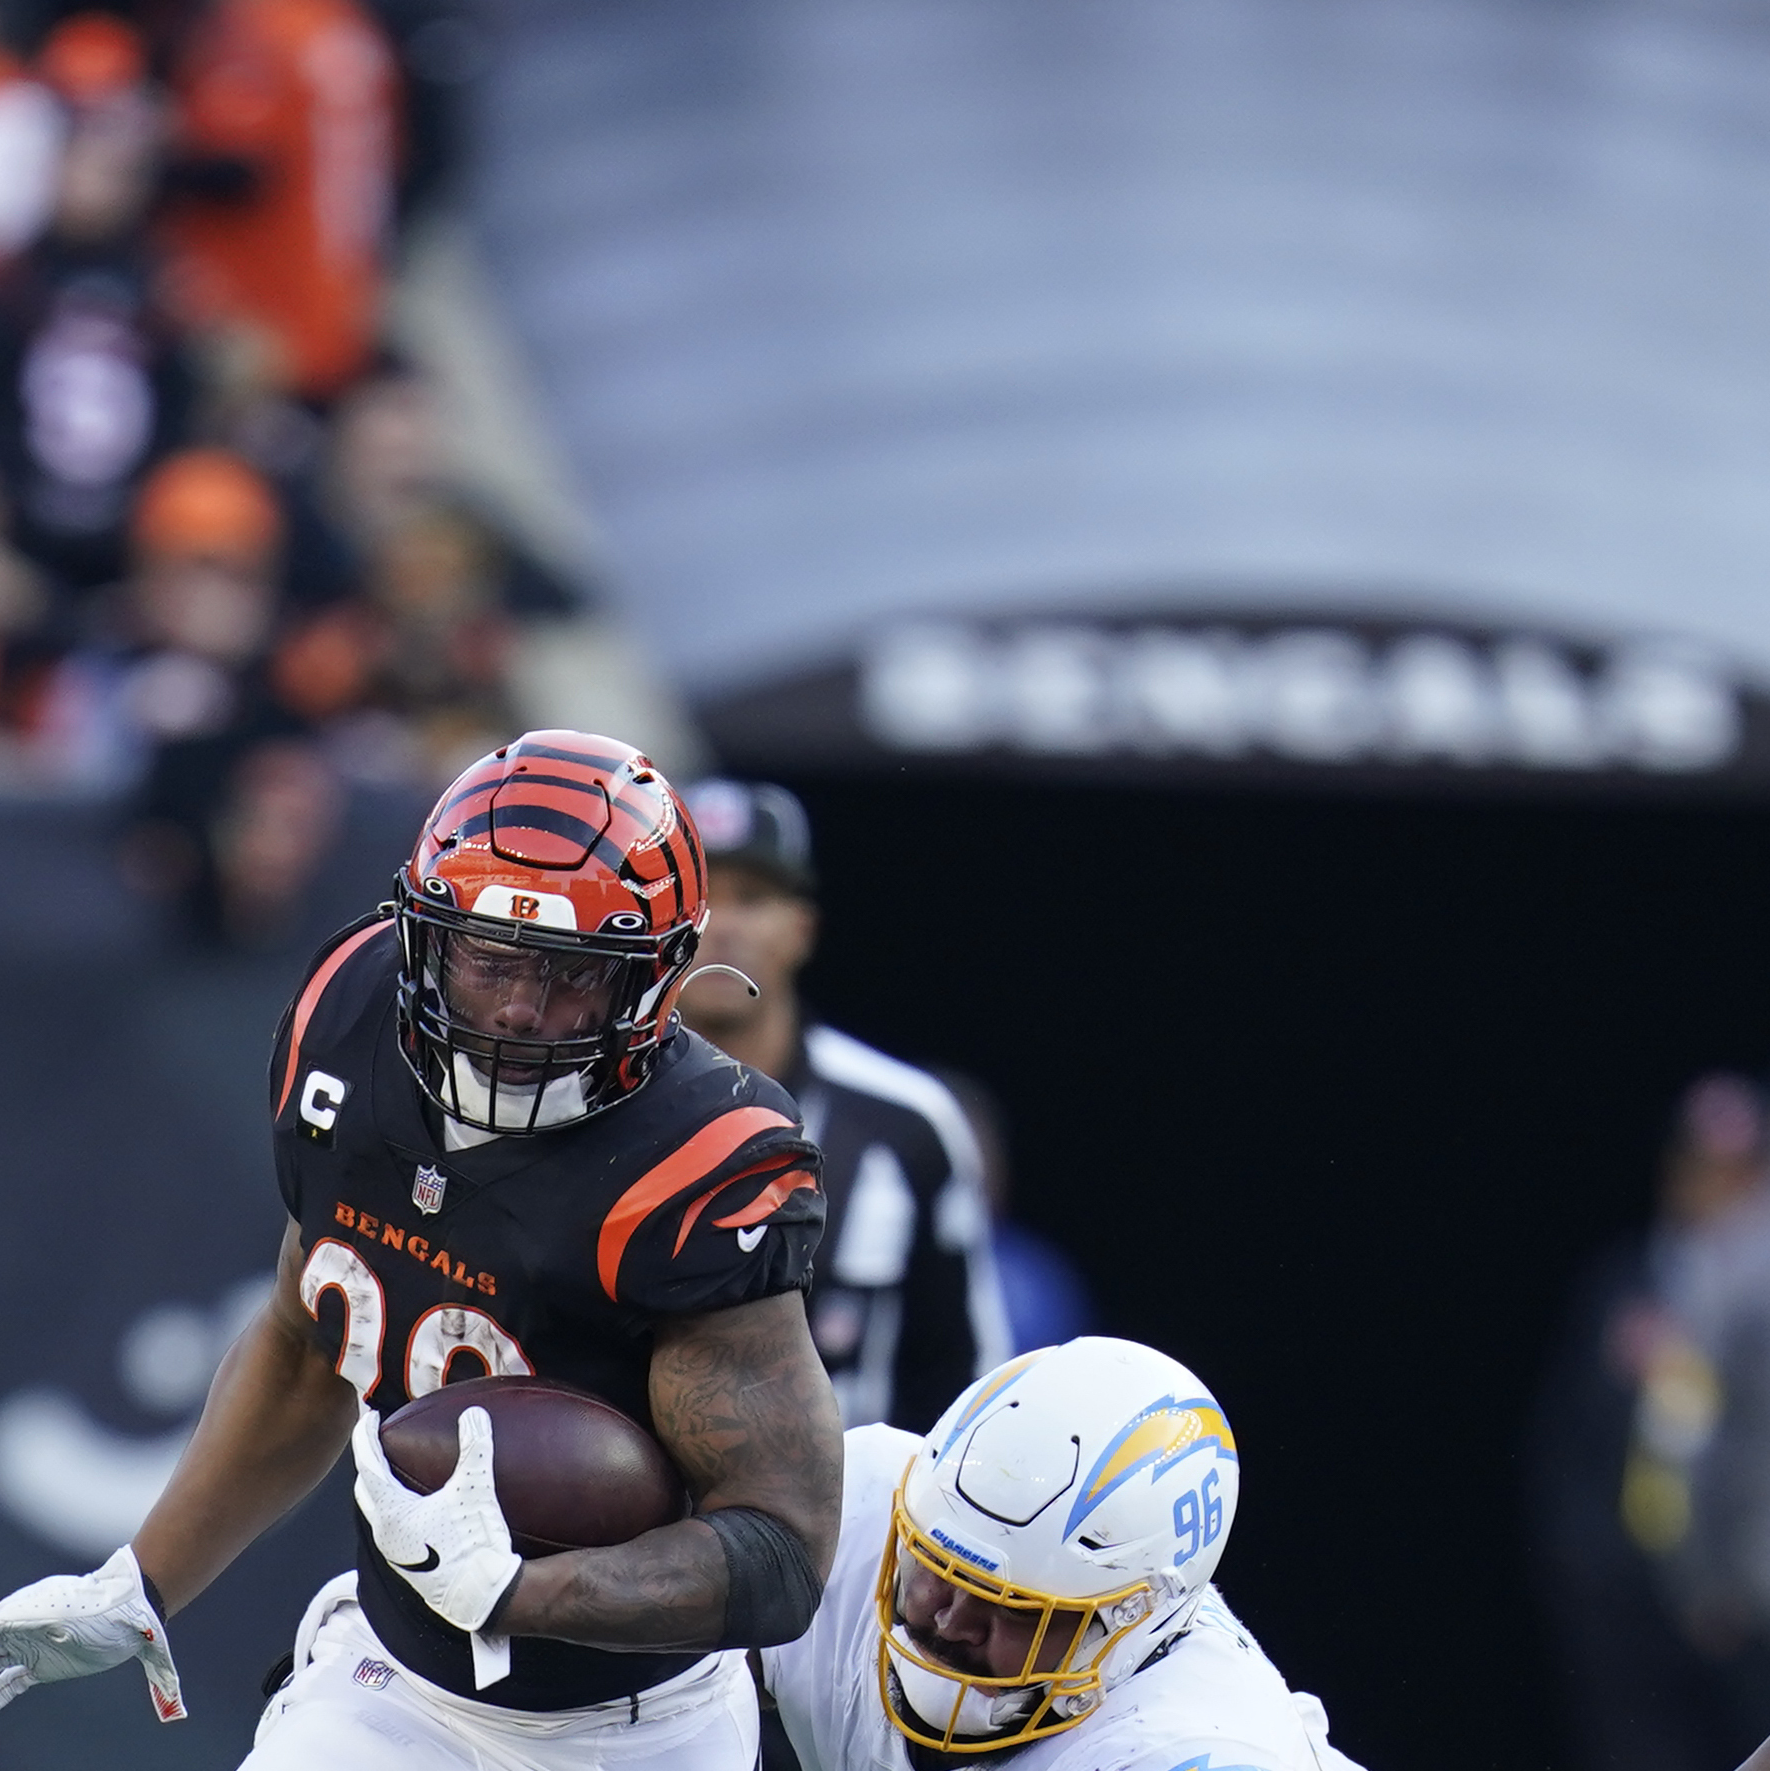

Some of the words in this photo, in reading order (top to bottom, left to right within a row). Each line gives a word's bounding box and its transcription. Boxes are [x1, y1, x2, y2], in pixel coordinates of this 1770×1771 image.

[863, 622, 1741, 776] BENGALS
[300, 1070, 347, 1131] C
[417, 1184, 437, 1207] NFL
[334, 1201, 497, 1296] BENGALS
[1173, 1467, 1222, 1567] 96
[931, 1528, 999, 1571] CHARGERS
[357, 1665, 382, 1684] NFL
